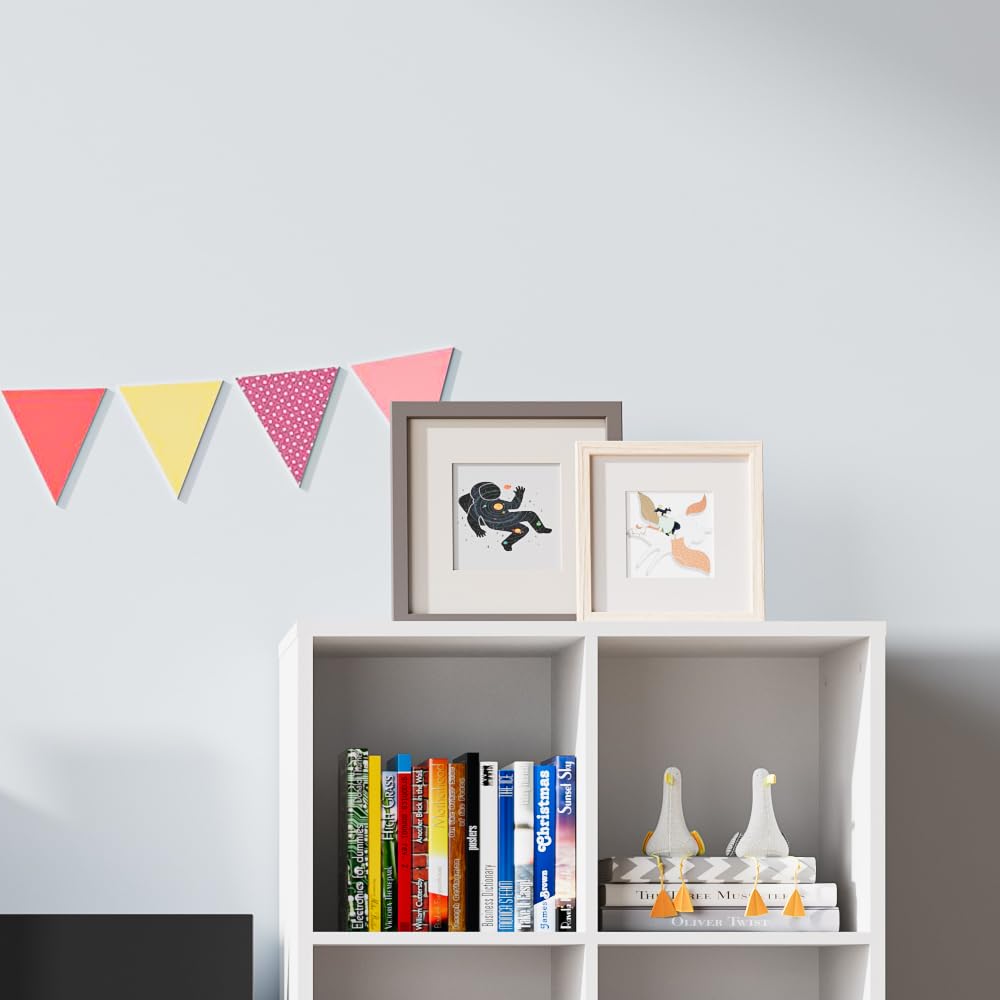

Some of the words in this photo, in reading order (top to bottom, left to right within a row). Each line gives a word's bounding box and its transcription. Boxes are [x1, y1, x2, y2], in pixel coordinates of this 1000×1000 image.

[415, 769, 423, 784] Wall
[499, 773, 514, 784] ICE
[556, 761, 576, 781] Sky
[381, 774, 395, 808] GRASS
[499, 785, 514, 797] THE
[556, 783, 573, 815] Sunset
[415, 801, 423, 818] Brick
[536, 769, 553, 853] Christmas
[351, 823, 364, 863] dummies
[415, 818, 423, 844] Another
[466, 825, 480, 851] posters
[351, 866, 364, 879] for
[481, 864, 497, 897] Dictionary
[539, 869, 551, 900] Brown
[351, 881, 364, 929] Electronics
[481, 898, 494, 927] Business
[540, 901, 550, 929] James
[414, 908, 423, 930] William
[516, 908, 532, 930] Take
[671, 916, 723, 927] OLIVER
[728, 915, 768, 927] TWIST
